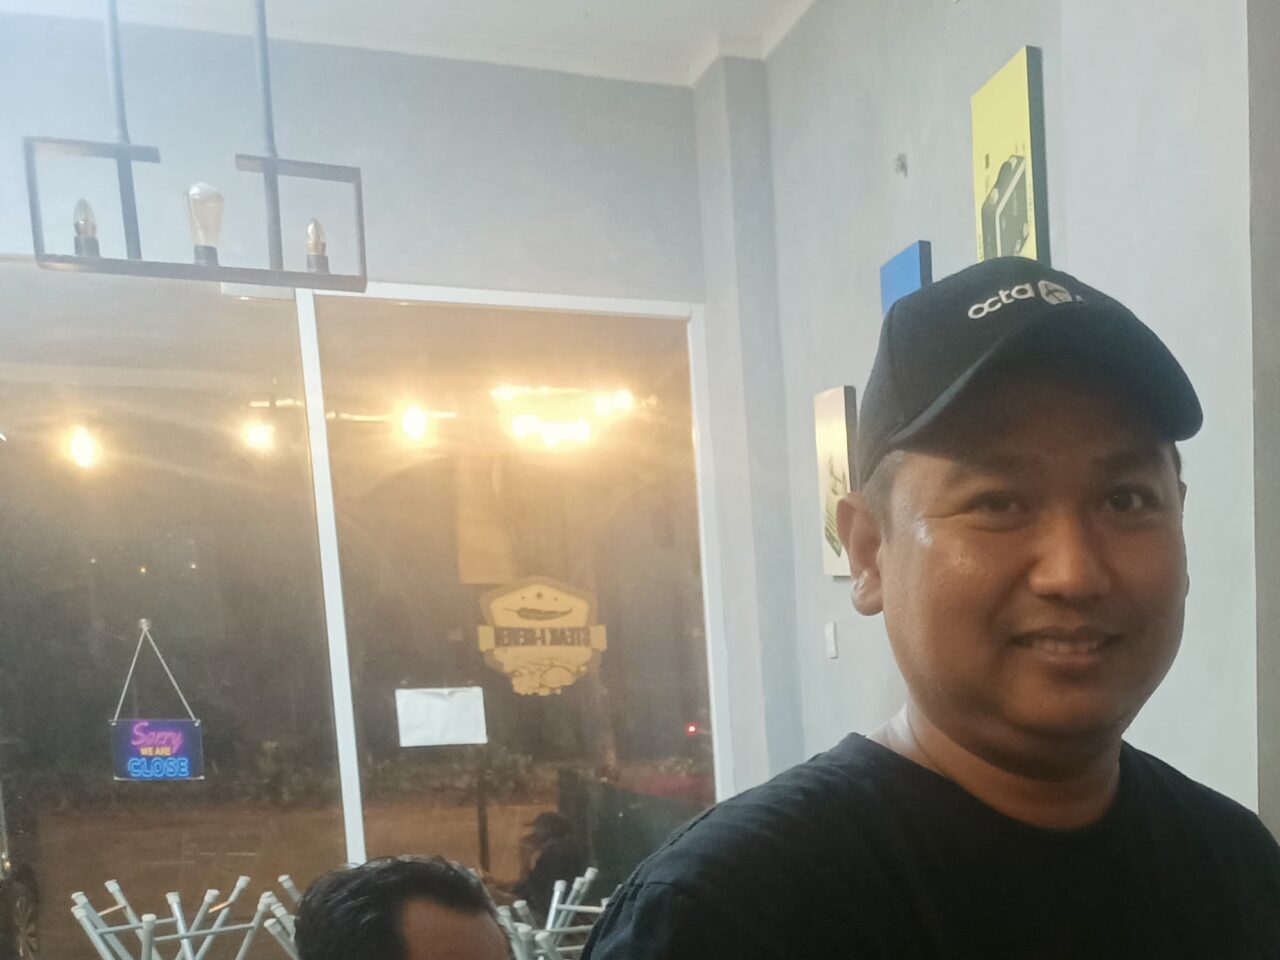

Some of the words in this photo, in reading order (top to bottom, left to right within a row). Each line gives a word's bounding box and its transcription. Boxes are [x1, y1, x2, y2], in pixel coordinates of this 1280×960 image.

[131, 722, 183, 754] Sorry
[140, 746, 154, 756] WE
[155, 746, 171, 756] ARE
[127, 757, 190, 777] CLOSE
